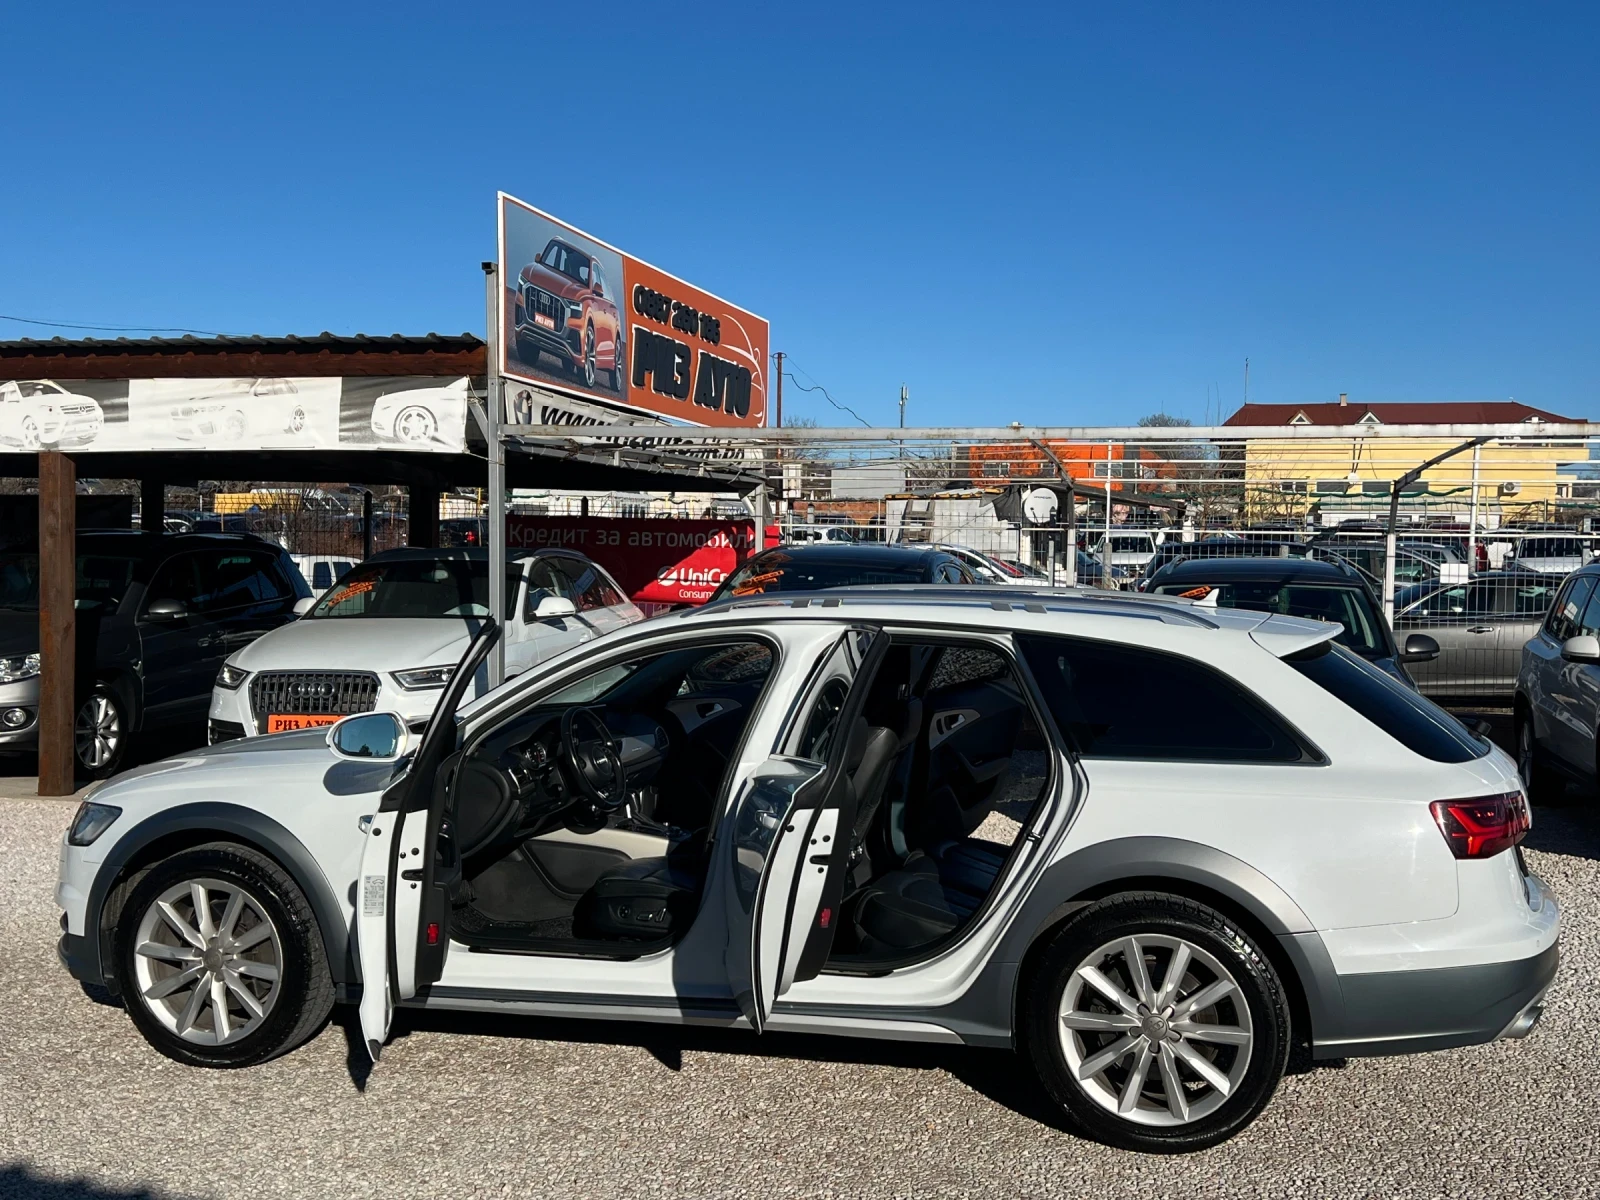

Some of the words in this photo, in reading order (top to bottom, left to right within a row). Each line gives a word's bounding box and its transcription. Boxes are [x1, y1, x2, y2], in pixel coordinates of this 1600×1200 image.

[631, 323, 691, 402] РИЗ
[692, 349, 752, 419] АУТО
[508, 524, 589, 546] Кредит
[595, 528, 622, 545] за
[678, 588, 715, 600] Consum
[275, 720, 299, 730] РИЗ
[305, 720, 338, 729] АУТ
